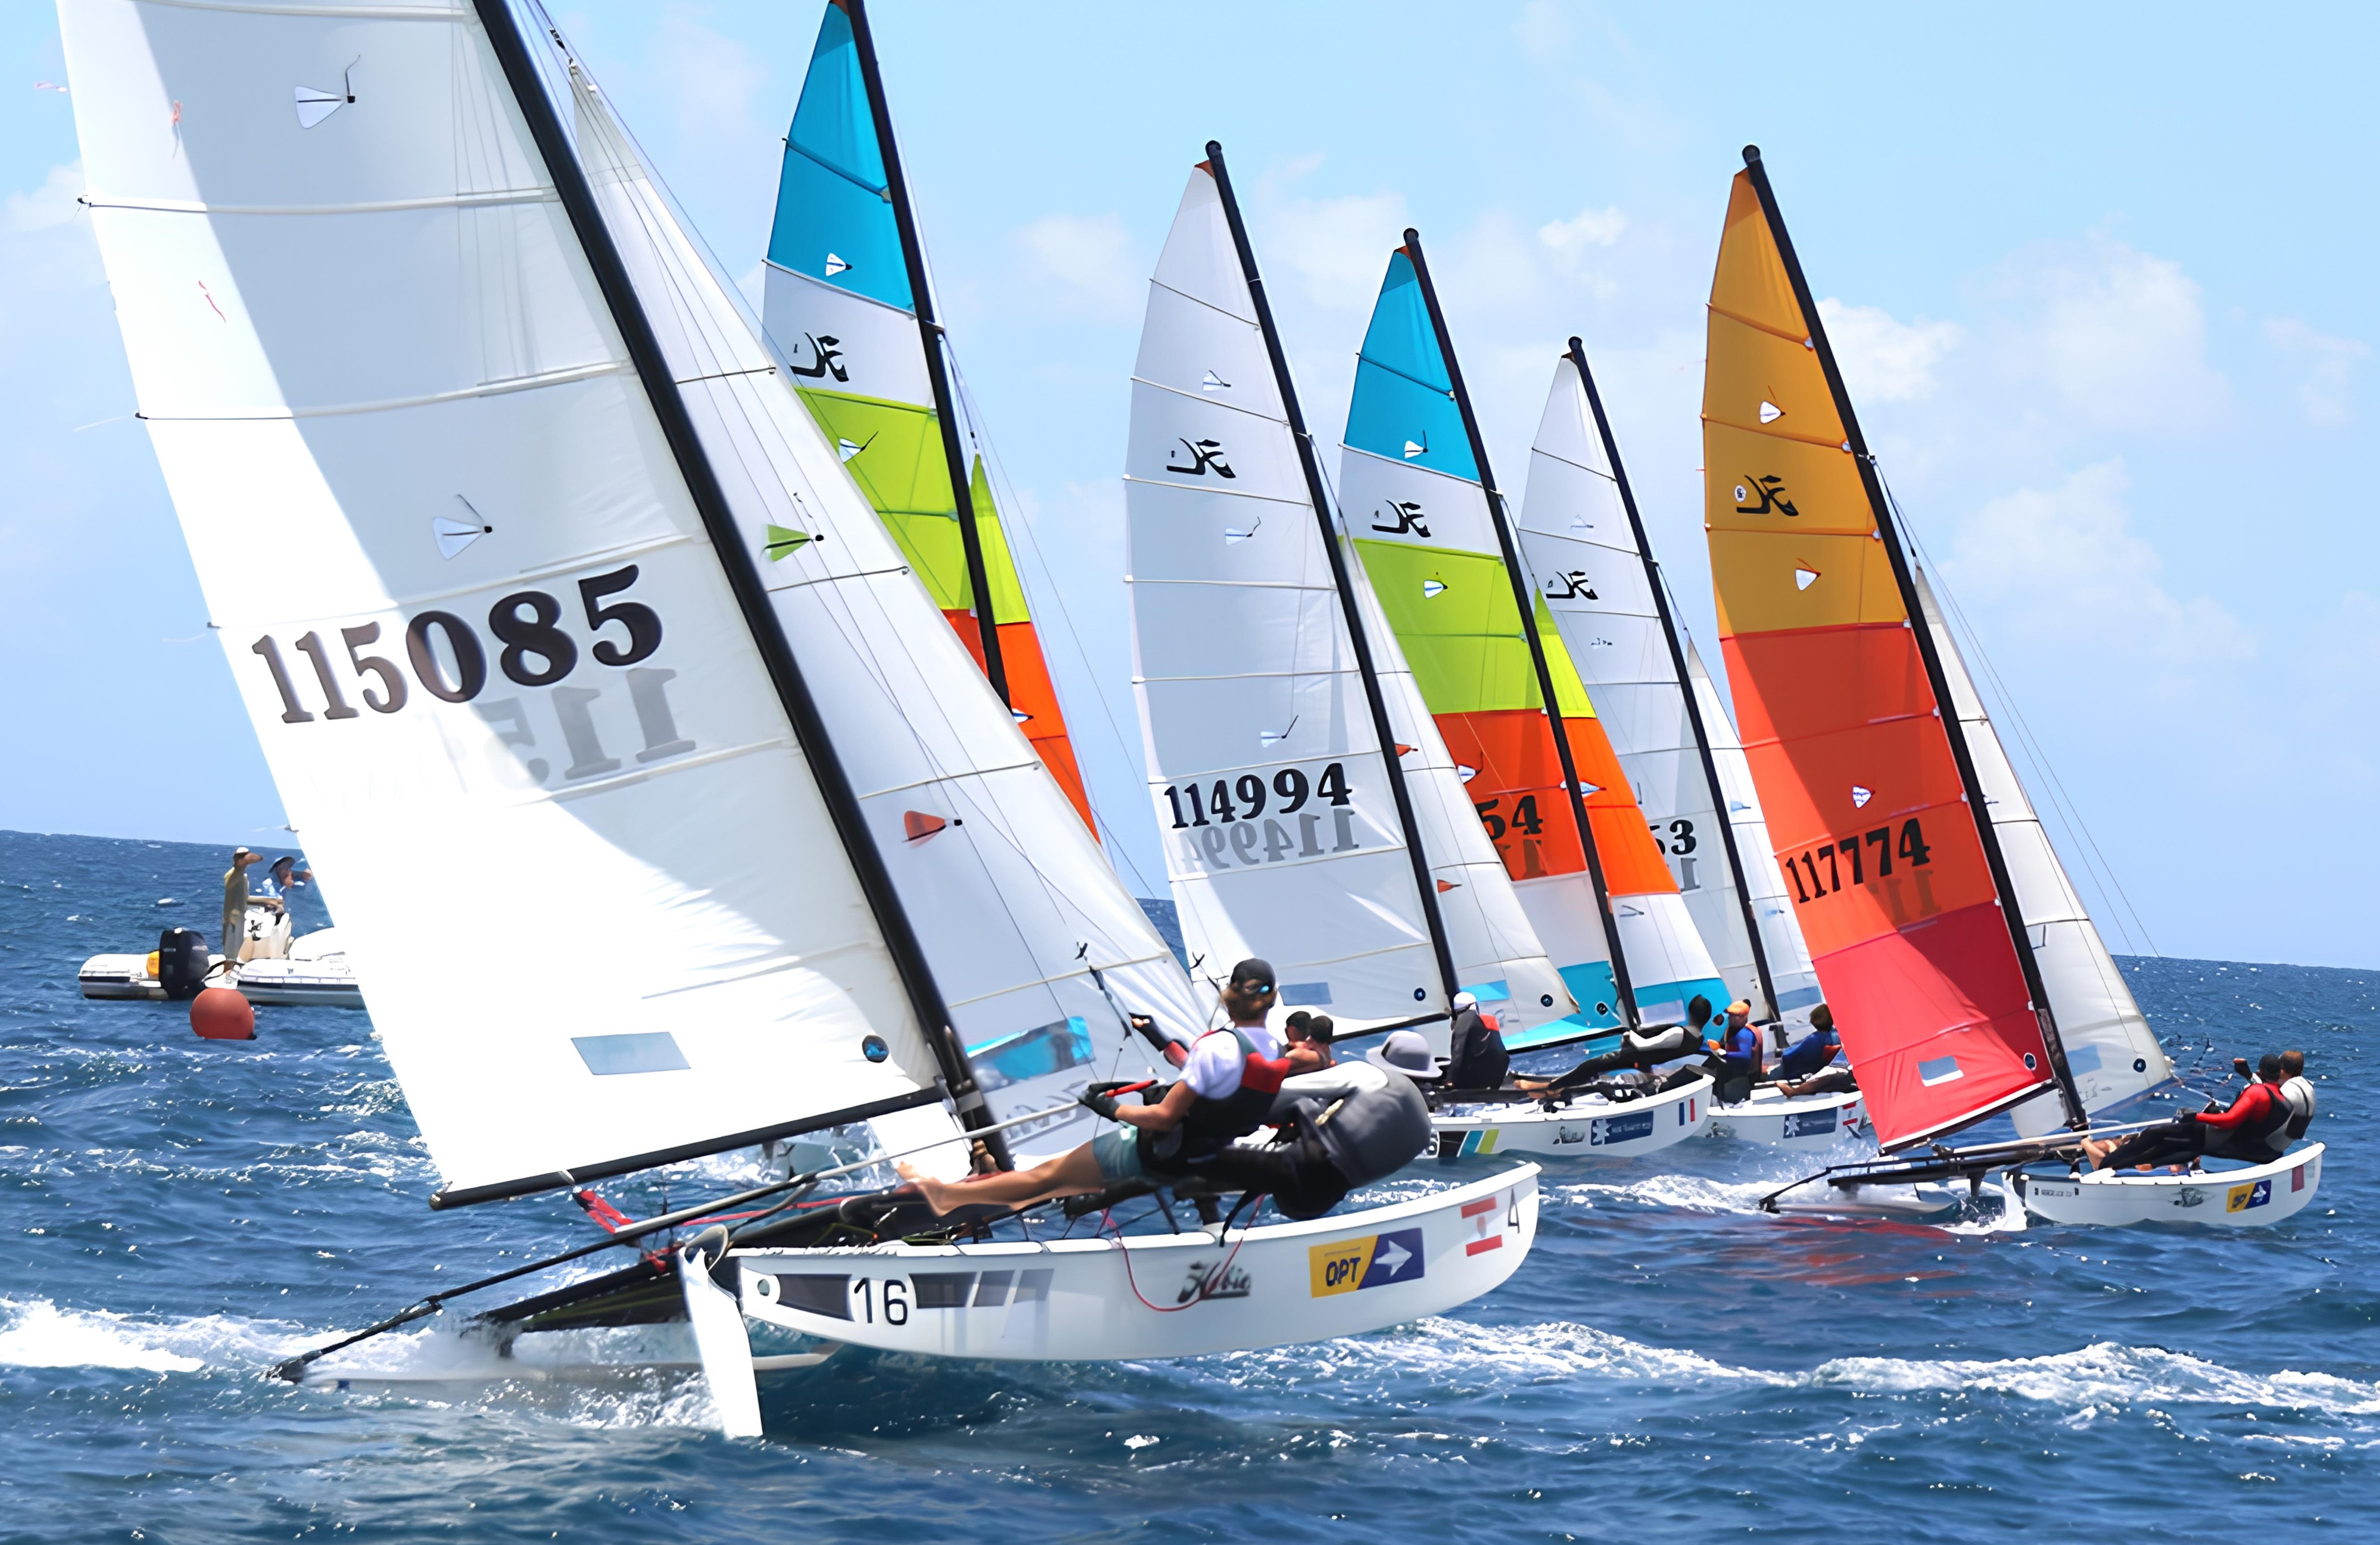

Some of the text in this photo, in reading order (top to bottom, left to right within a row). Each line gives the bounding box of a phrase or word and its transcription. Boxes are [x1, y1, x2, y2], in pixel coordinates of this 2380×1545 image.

[252, 564, 663, 724] 115085
[1164, 762, 1353, 829] 114994
[1785, 818, 1931, 904] 117774
[853, 1276, 908, 1326] 16
